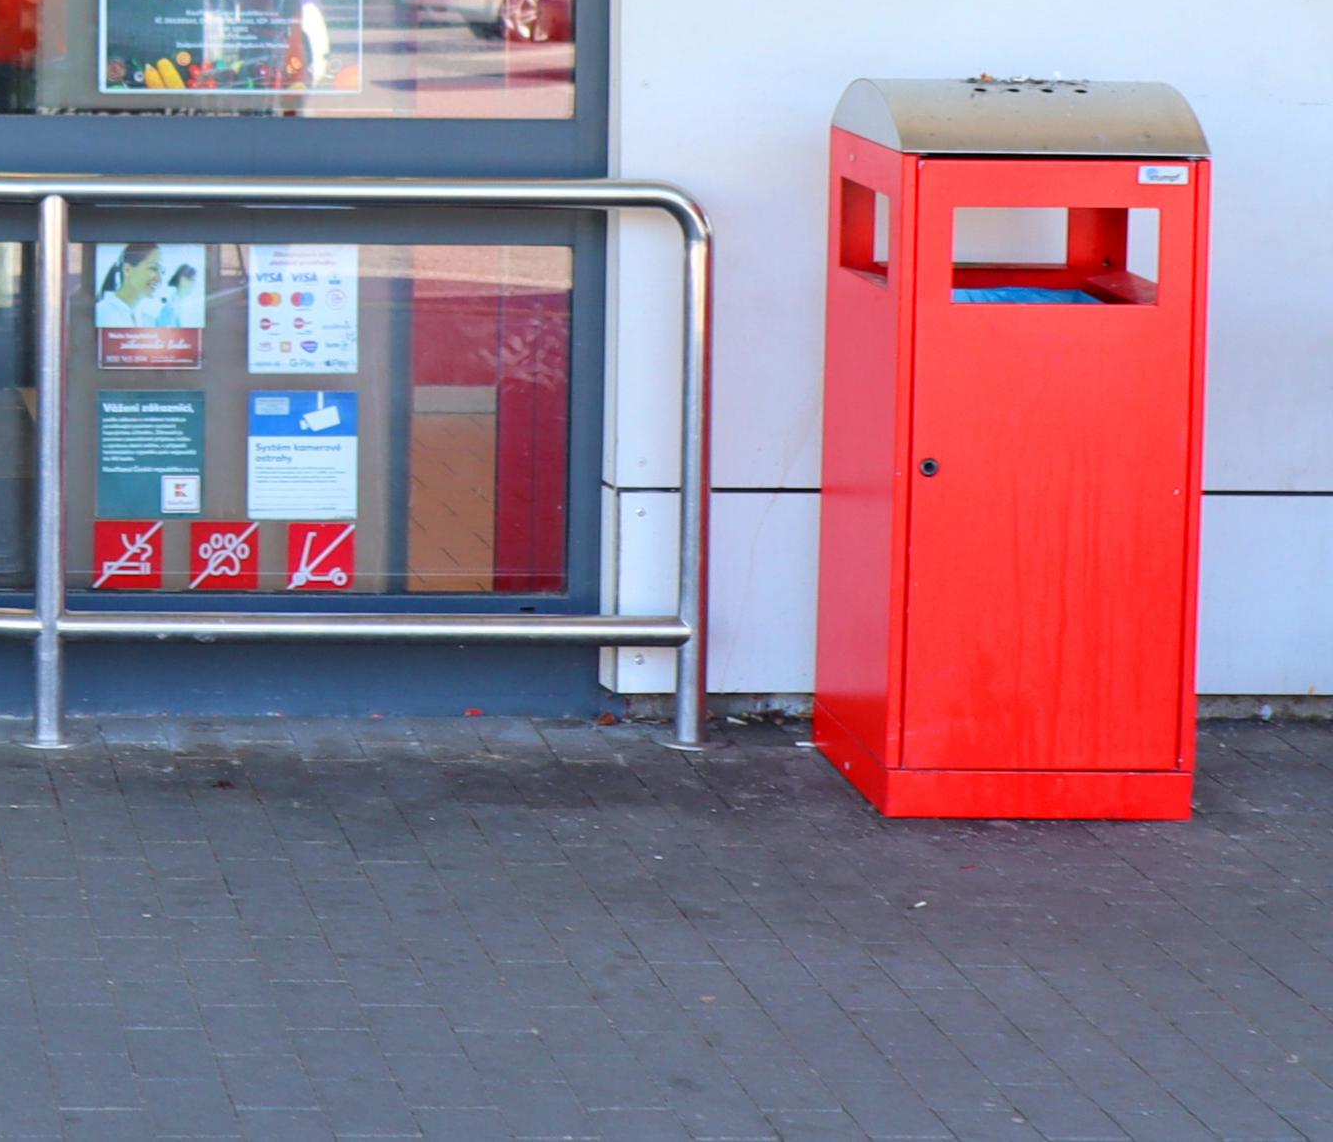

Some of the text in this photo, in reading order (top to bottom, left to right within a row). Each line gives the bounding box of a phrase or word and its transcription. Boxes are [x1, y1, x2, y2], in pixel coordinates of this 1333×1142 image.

[256, 272, 283, 282] VISA
[291, 272, 318, 282] VISA
[255, 443, 291, 453] Systém
[255, 454, 293, 464] ostrahy
